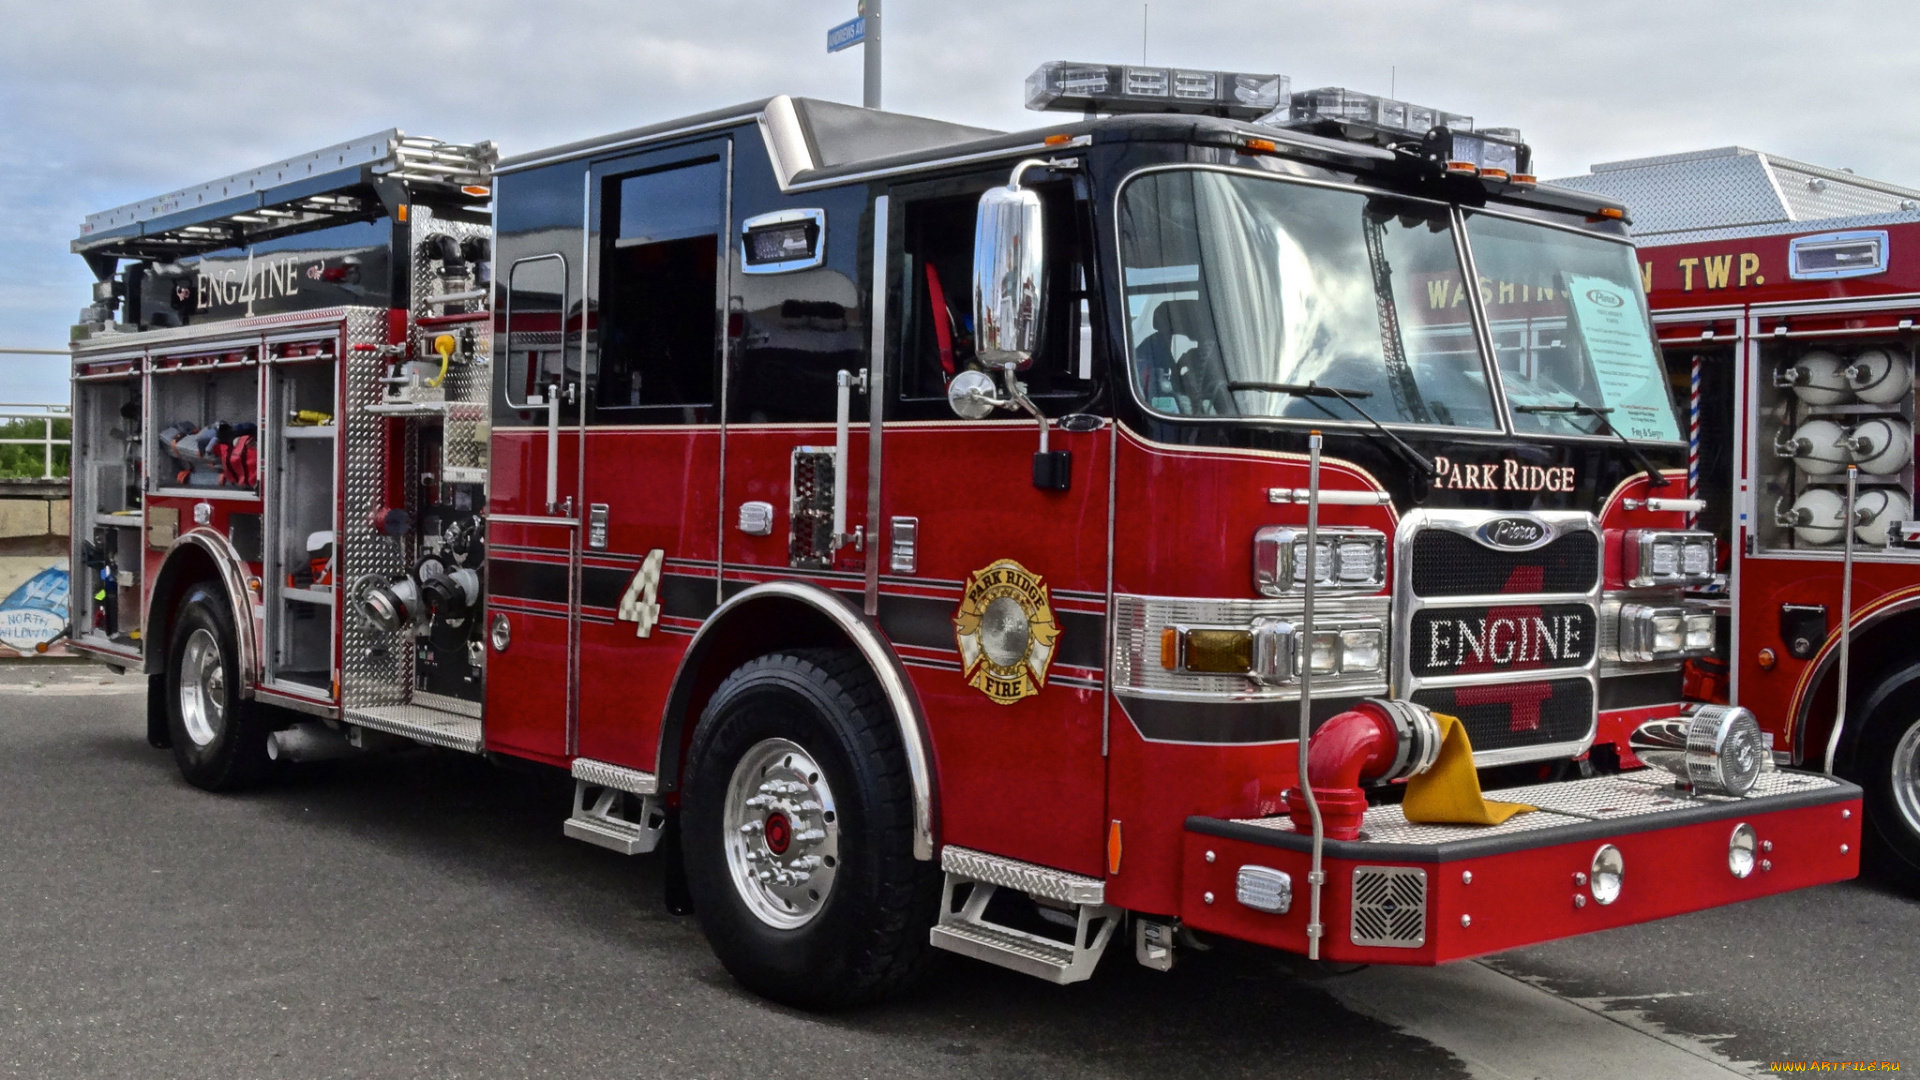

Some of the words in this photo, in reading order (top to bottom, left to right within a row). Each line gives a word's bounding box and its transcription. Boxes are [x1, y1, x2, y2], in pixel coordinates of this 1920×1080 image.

[1679, 252, 1766, 292] TWP.
[1434, 456, 1499, 490] PARK
[1503, 459, 1576, 492] RIDGE
[1494, 519, 1538, 544] Pierce
[618, 548, 664, 638] 4
[969, 571, 1003, 605] PARK
[1006, 570, 1046, 611] RIDGE
[1427, 614, 1583, 667] ENGINE
[985, 677, 1022, 698] FIRE
